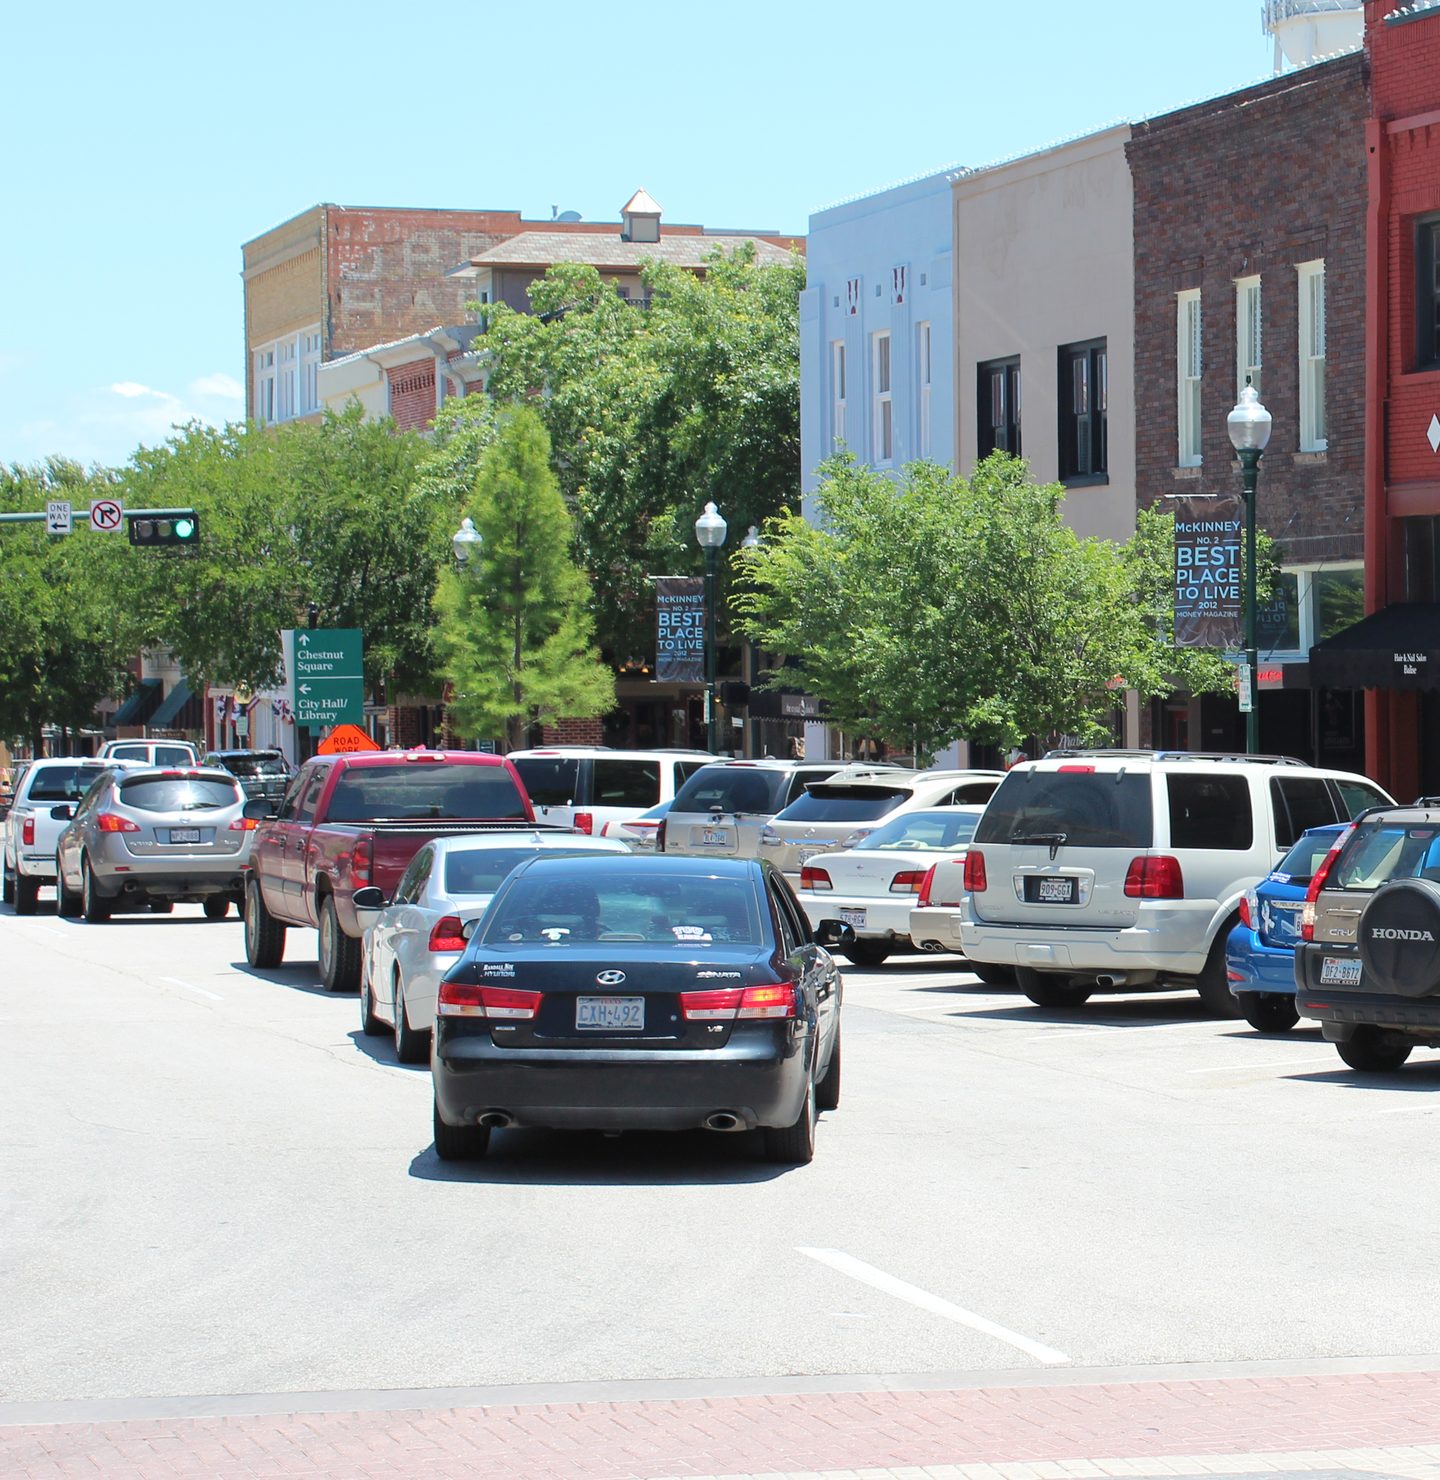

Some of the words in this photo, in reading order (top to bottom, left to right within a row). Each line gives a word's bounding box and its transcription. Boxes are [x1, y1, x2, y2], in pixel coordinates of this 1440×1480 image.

[50, 504, 68, 512] ONE
[1175, 521, 1241, 533] McKINNEY
[1196, 537, 1212, 545] NO.
[1177, 545, 1239, 566] BEST
[1176, 568, 1239, 584] PLACE
[1175, 586, 1199, 600] TO
[1204, 586, 1239, 599] LIVE
[657, 595, 704, 603] McKINNEY
[1198, 601, 1218, 609] 2012
[658, 612, 703, 626] BEST
[658, 627, 703, 639] PLACE
[658, 640, 674, 649] TO
[678, 640, 703, 649] LIVE
[297, 650, 344, 659] Chestnut
[297, 661, 333, 673] Square
[298, 699, 320, 709] City
[322, 698, 348, 708] Hall/
[299, 711, 337, 721] Library
[333, 737, 360, 745] ROAD
[1329, 928, 1356, 937] CR-V
[1371, 927, 1435, 942] HONDA
